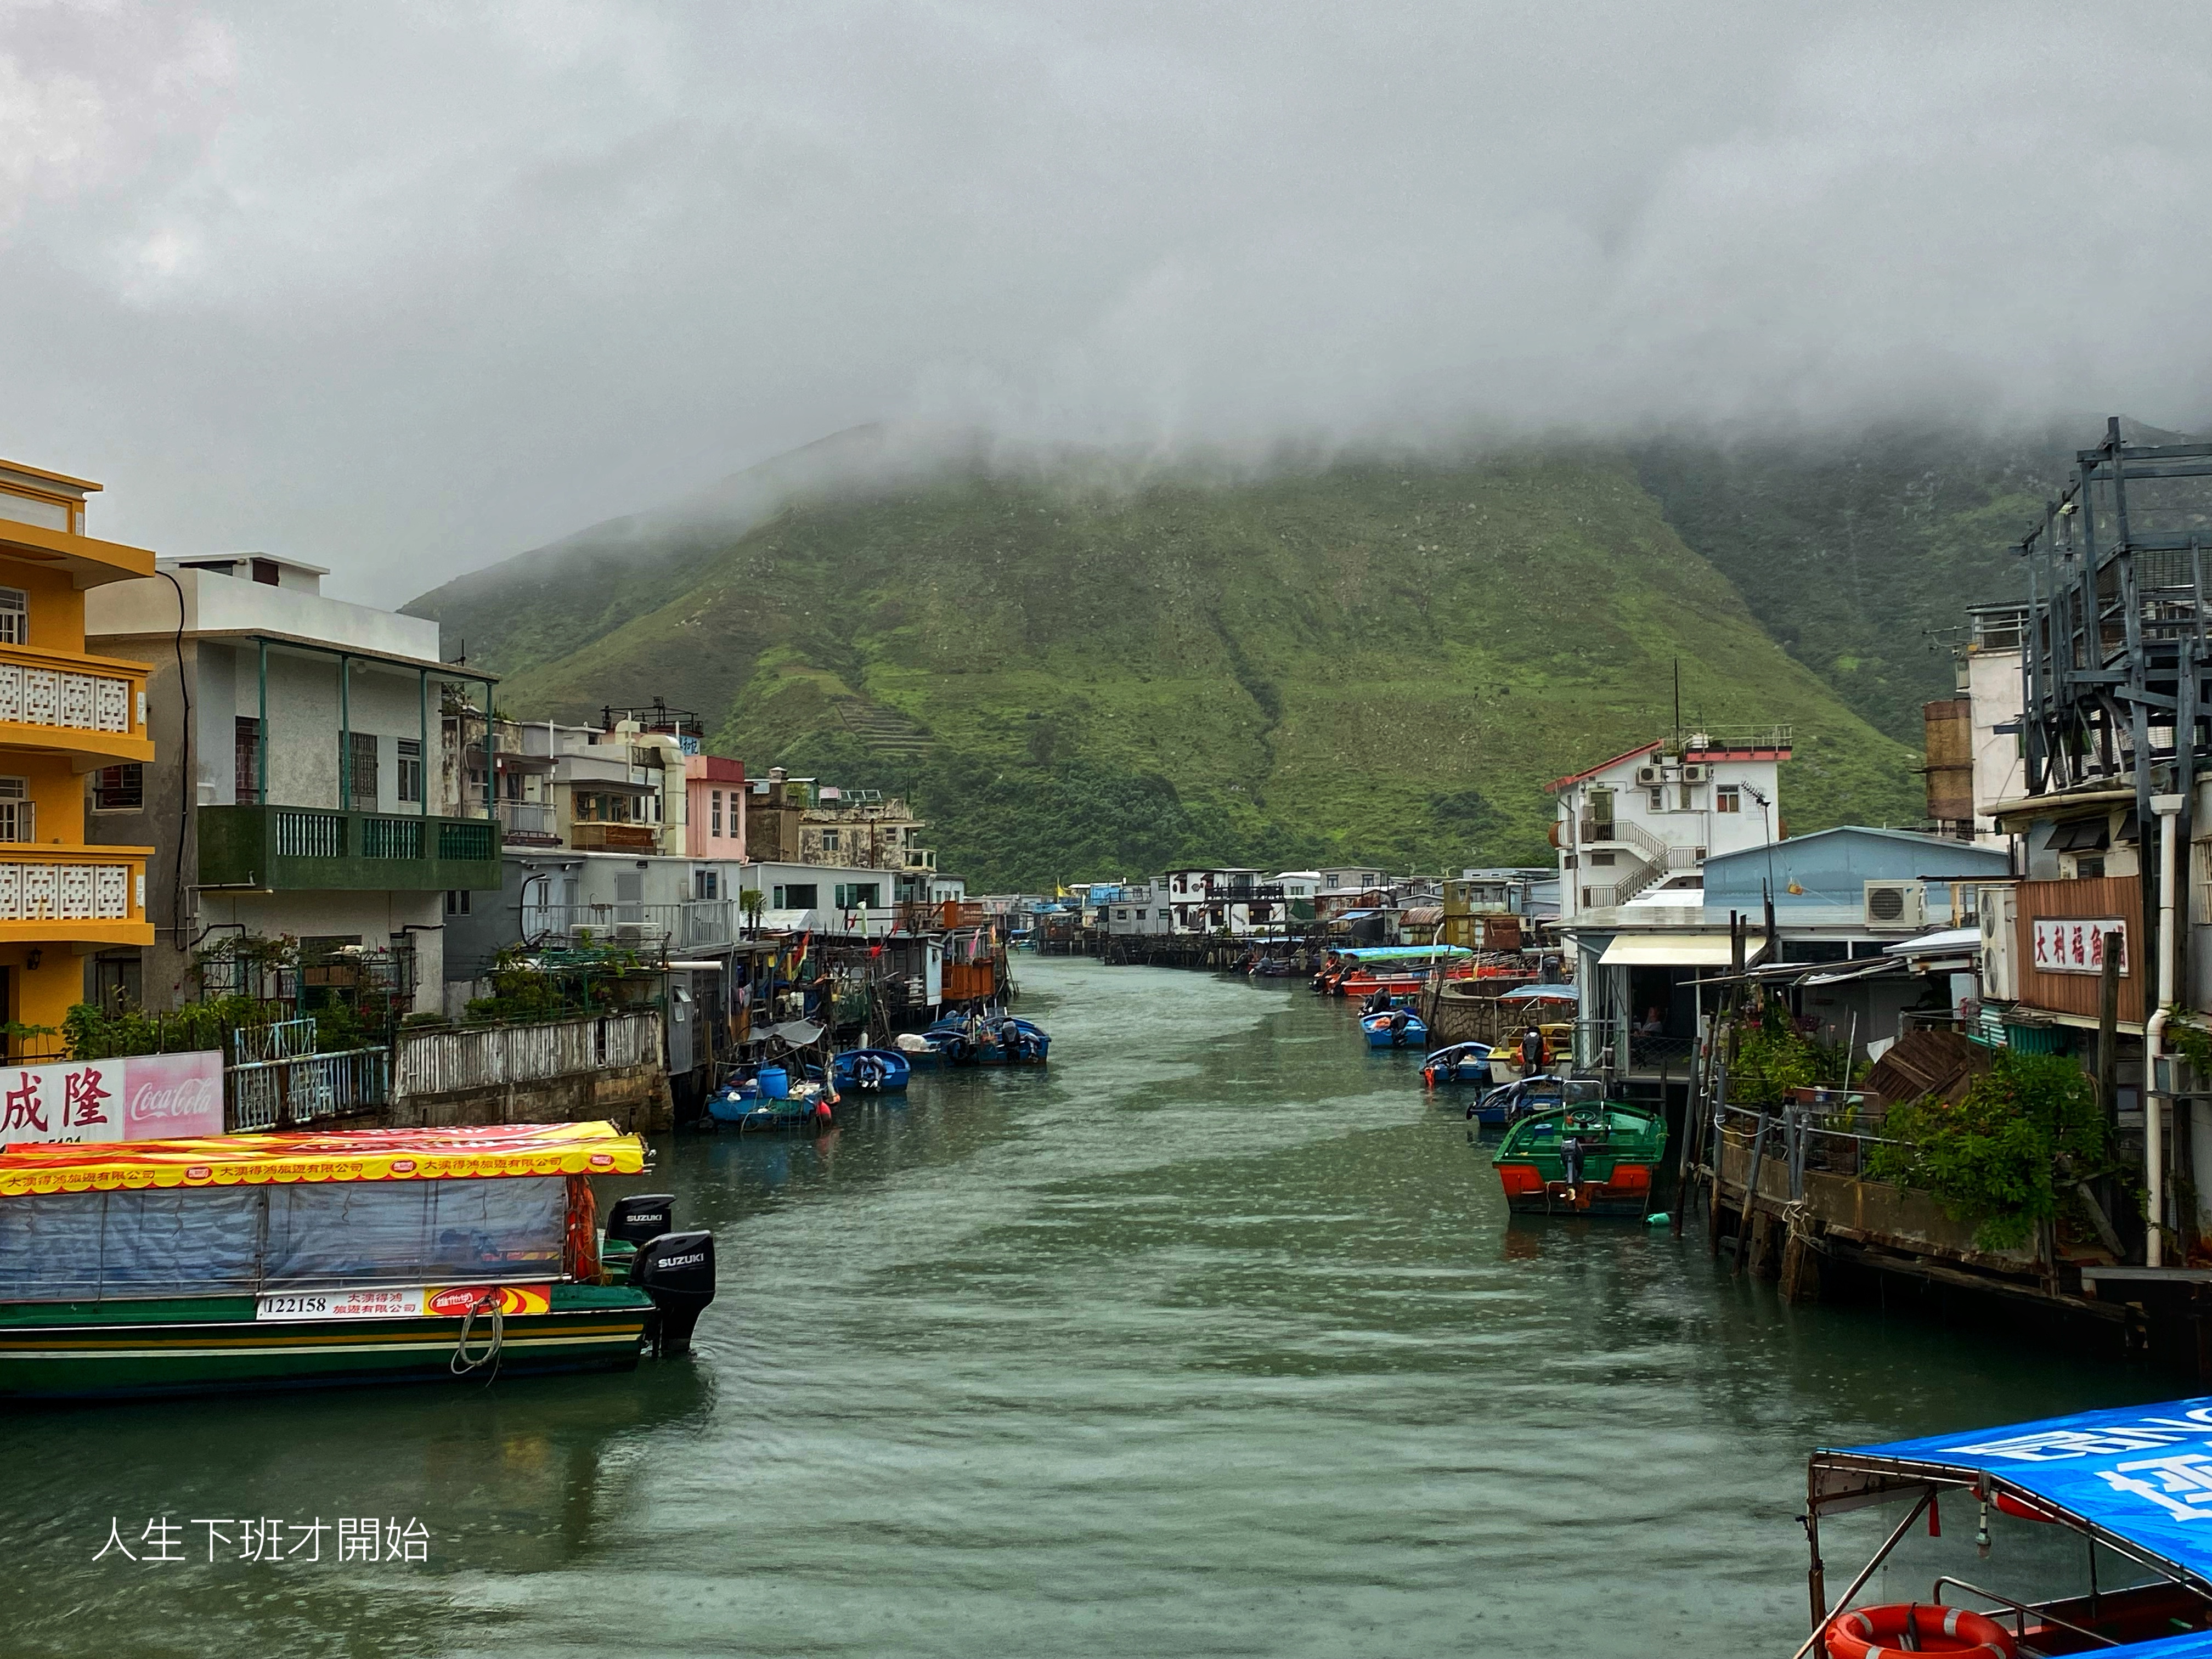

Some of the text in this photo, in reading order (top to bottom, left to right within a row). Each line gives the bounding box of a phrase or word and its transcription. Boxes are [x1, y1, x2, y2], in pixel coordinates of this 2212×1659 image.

[2037, 924, 2126, 968] 大利福魚
[0, 1066, 112, 1132] 成隆
[658, 1253, 704, 1268] SUZUKI
[267, 1297, 326, 1313] 122158
[332, 1304, 416, 1315] 旅遊有限公司
